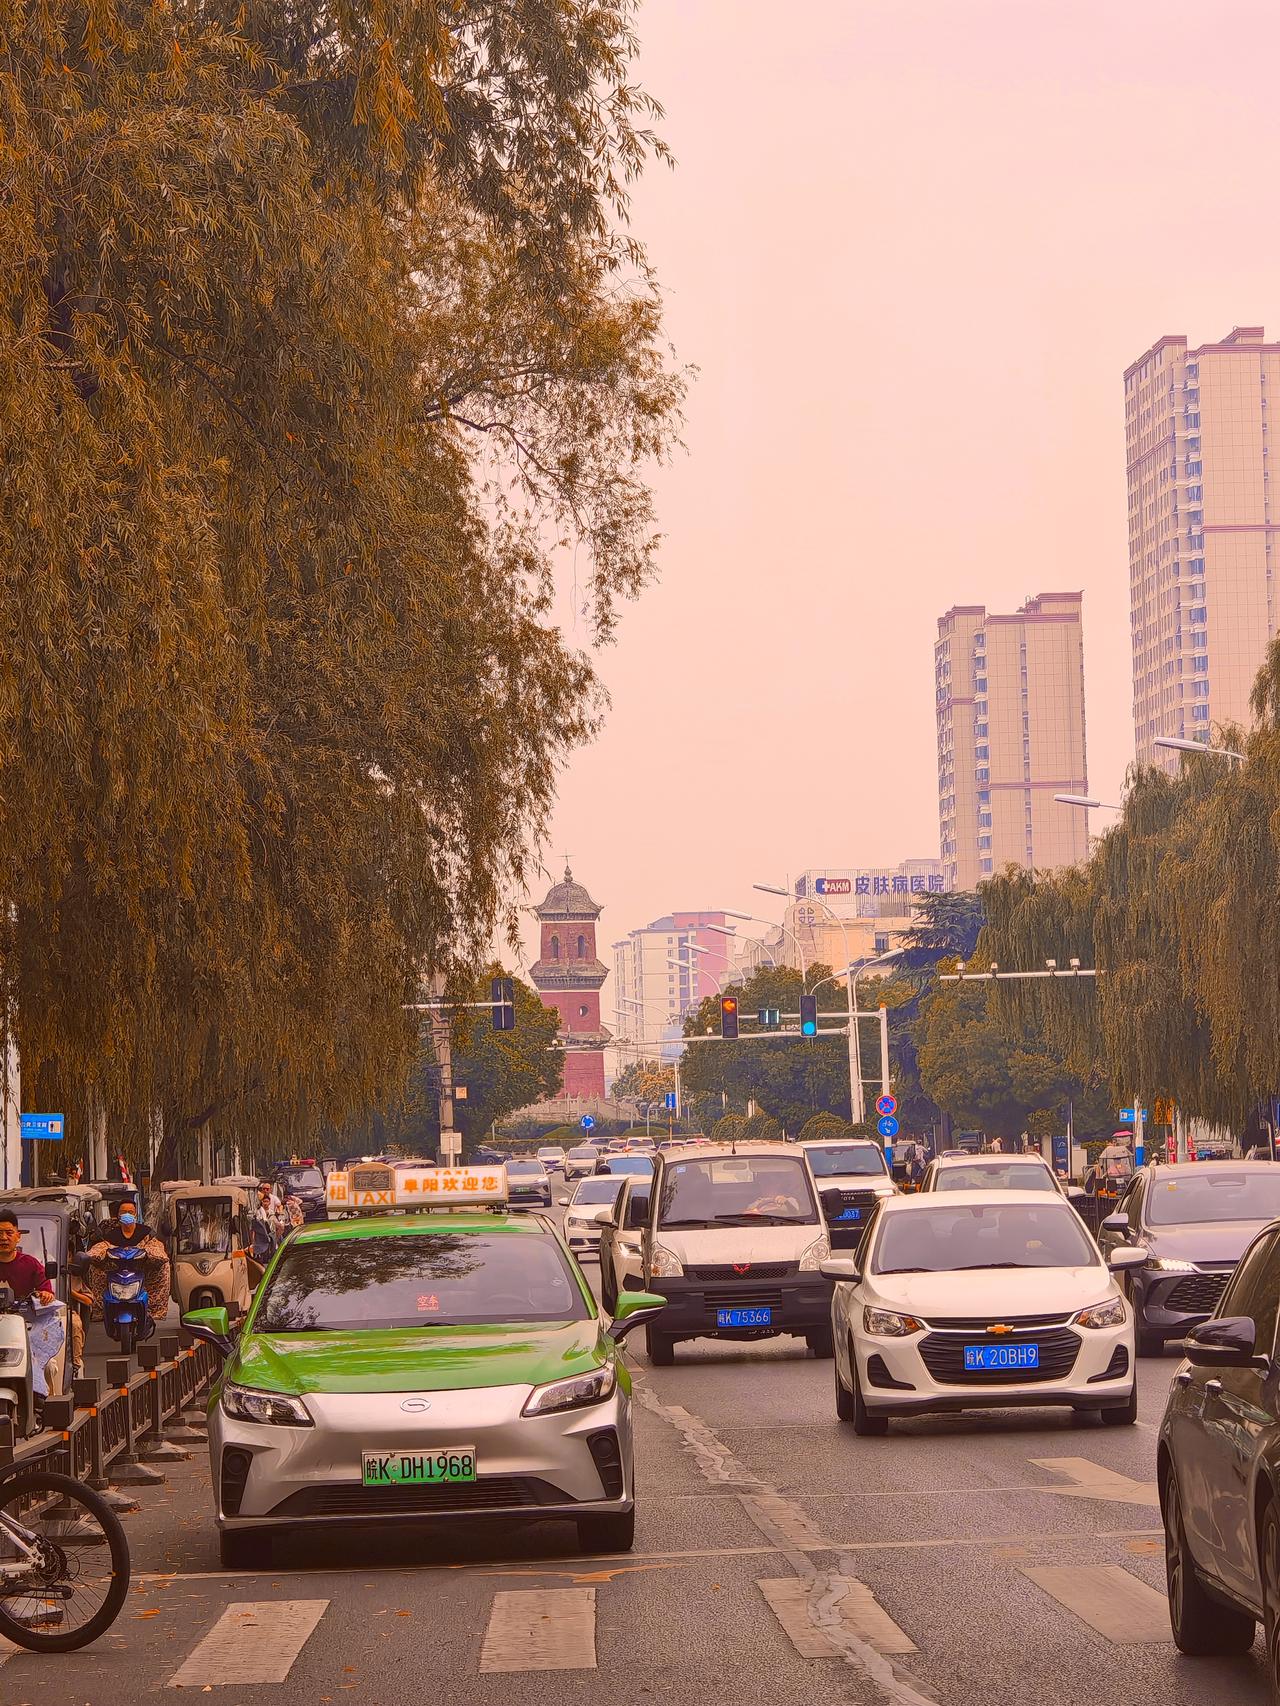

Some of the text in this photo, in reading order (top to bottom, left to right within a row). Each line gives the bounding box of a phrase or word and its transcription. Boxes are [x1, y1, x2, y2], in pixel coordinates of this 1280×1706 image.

[829, 881, 850, 892] AKM
[855, 875, 945, 895] 皮肤病医院
[403, 1177, 498, 1193] 阜阳欢迎您
[353, 1191, 397, 1205] TAXI
